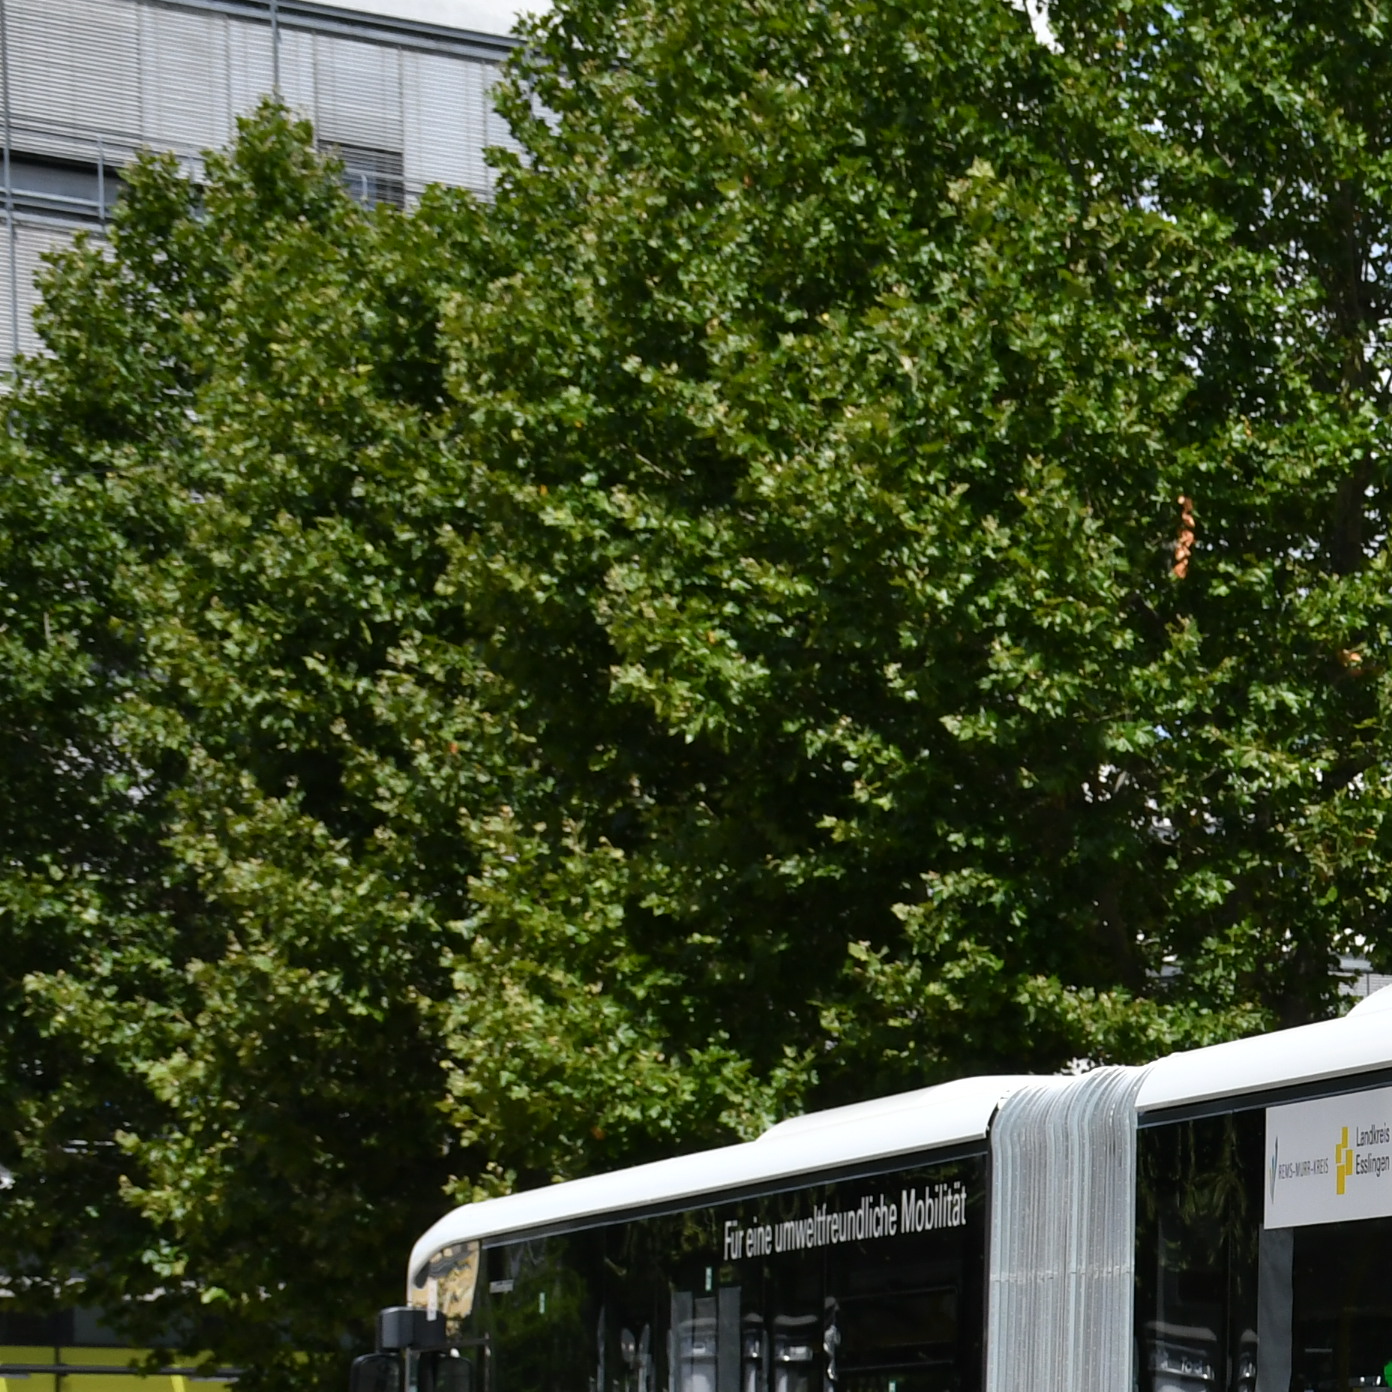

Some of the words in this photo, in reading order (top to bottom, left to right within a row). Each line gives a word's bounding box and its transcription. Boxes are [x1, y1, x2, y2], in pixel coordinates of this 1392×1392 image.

[1356, 1122, 1390, 1147] Landkreis
[1355, 1153, 1390, 1177] Esslingen
[724, 1220, 745, 1260] Für
[746, 1216, 772, 1258] eine
[775, 1194, 898, 1253] umweltfreundliche
[901, 1181, 967, 1234] Mobilität
